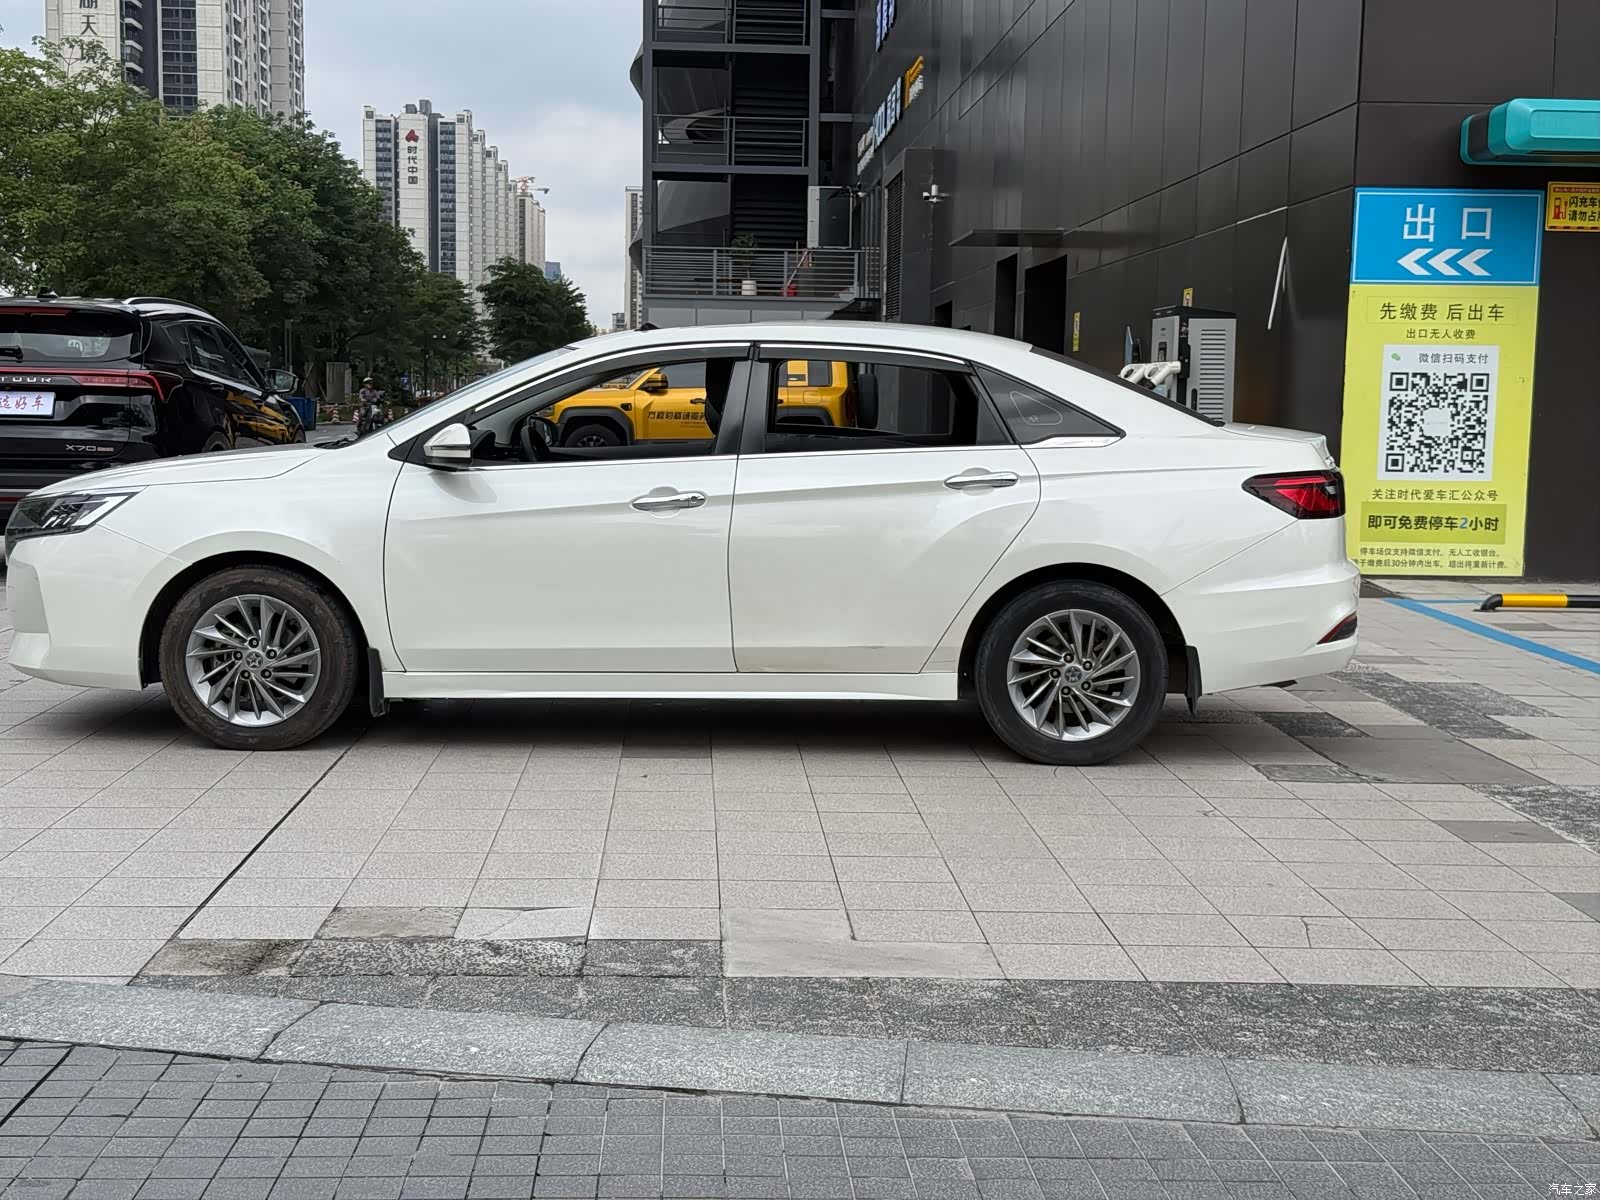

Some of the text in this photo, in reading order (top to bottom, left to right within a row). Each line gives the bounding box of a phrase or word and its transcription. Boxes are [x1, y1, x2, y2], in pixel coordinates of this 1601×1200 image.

[407, 145, 418, 184] 时代中国
[1568, 195, 1600, 208] 闪充车
[1403, 203, 1493, 243] 出口
[1379, 302, 1505, 322] 先缴费 后出车
[1405, 328, 1477, 340] 出口无人收费
[1418, 352, 1489, 365] 微信扫码支付
[65, 444, 97, 452] X70
[1371, 487, 1499, 502] 关注时代爱车汇公众号
[1367, 514, 1500, 531] 即可免费停车2小时
